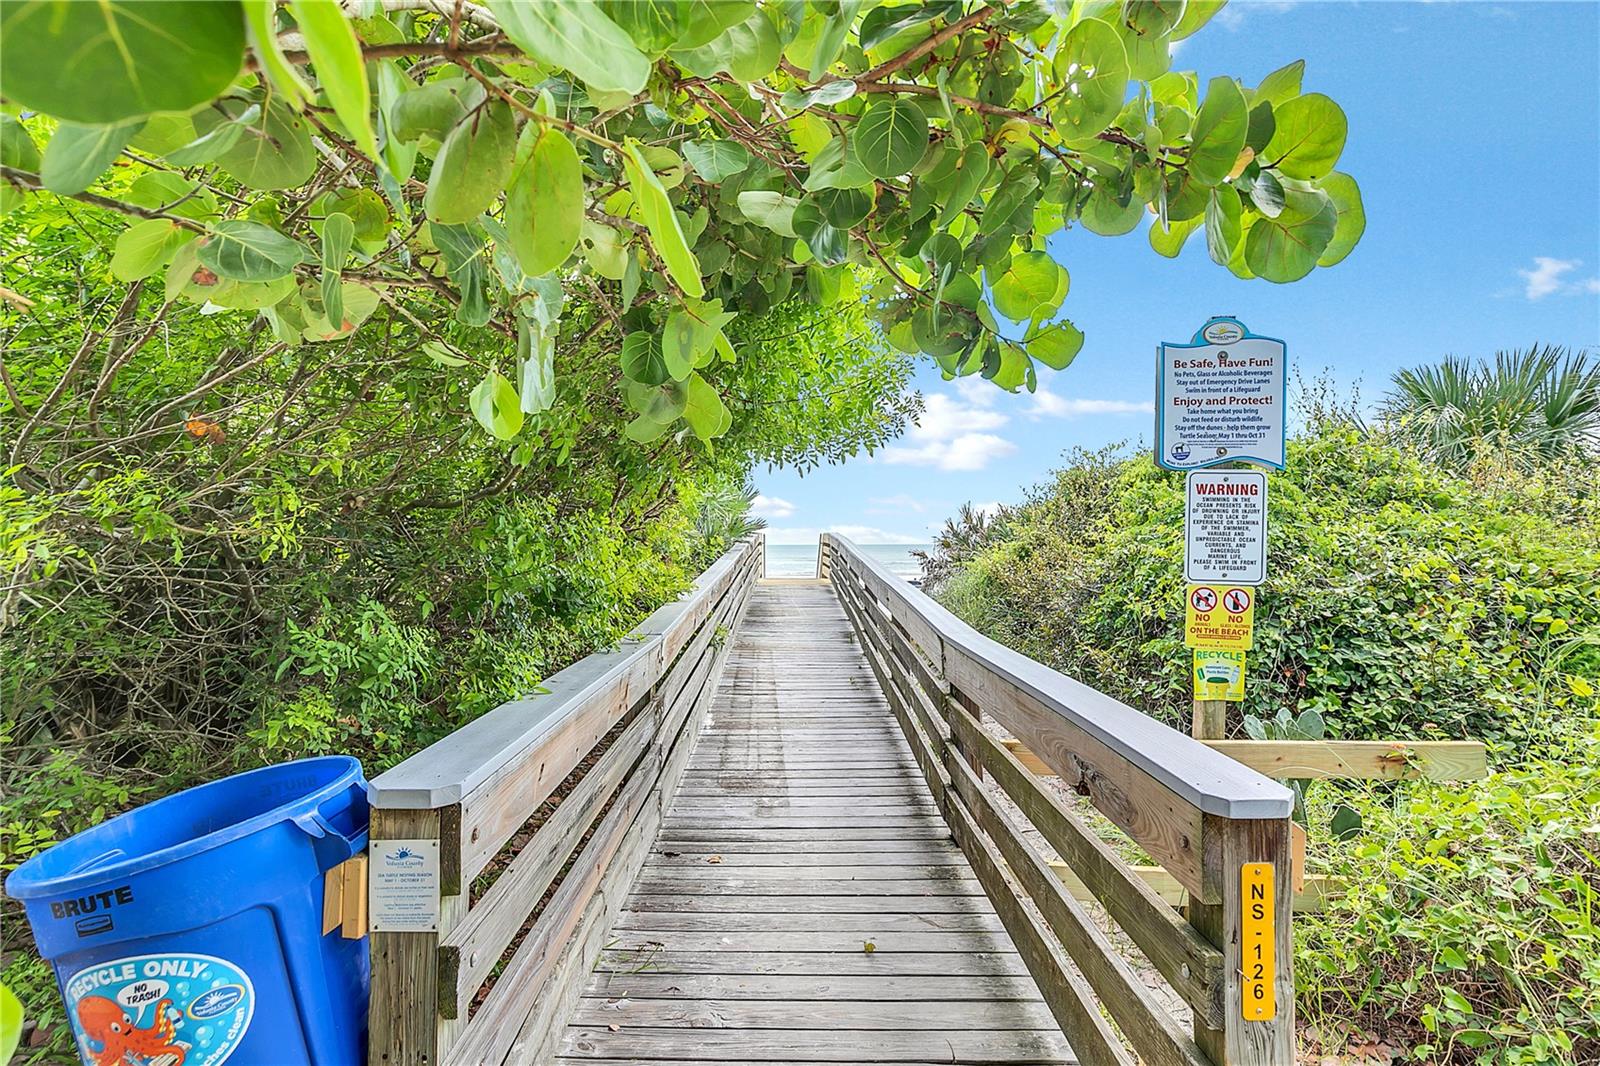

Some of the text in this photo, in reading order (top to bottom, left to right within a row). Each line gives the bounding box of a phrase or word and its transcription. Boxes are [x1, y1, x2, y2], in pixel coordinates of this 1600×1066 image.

[1174, 358, 1273, 369] Be Safe, Have Fun!
[1174, 395, 1273, 407] Enjoy and Protect!
[1196, 484, 1258, 495] WARNING
[1196, 651, 1242, 662] RECYCLE
[50, 885, 134, 919] BRUTE
[70, 960, 209, 1001] RECYCLE ONLY
[134, 983, 147, 994] NO
[126, 988, 160, 1005] TRASH!
[200, 1041, 230, 1066] ches
[227, 1007, 245, 1040] clean
